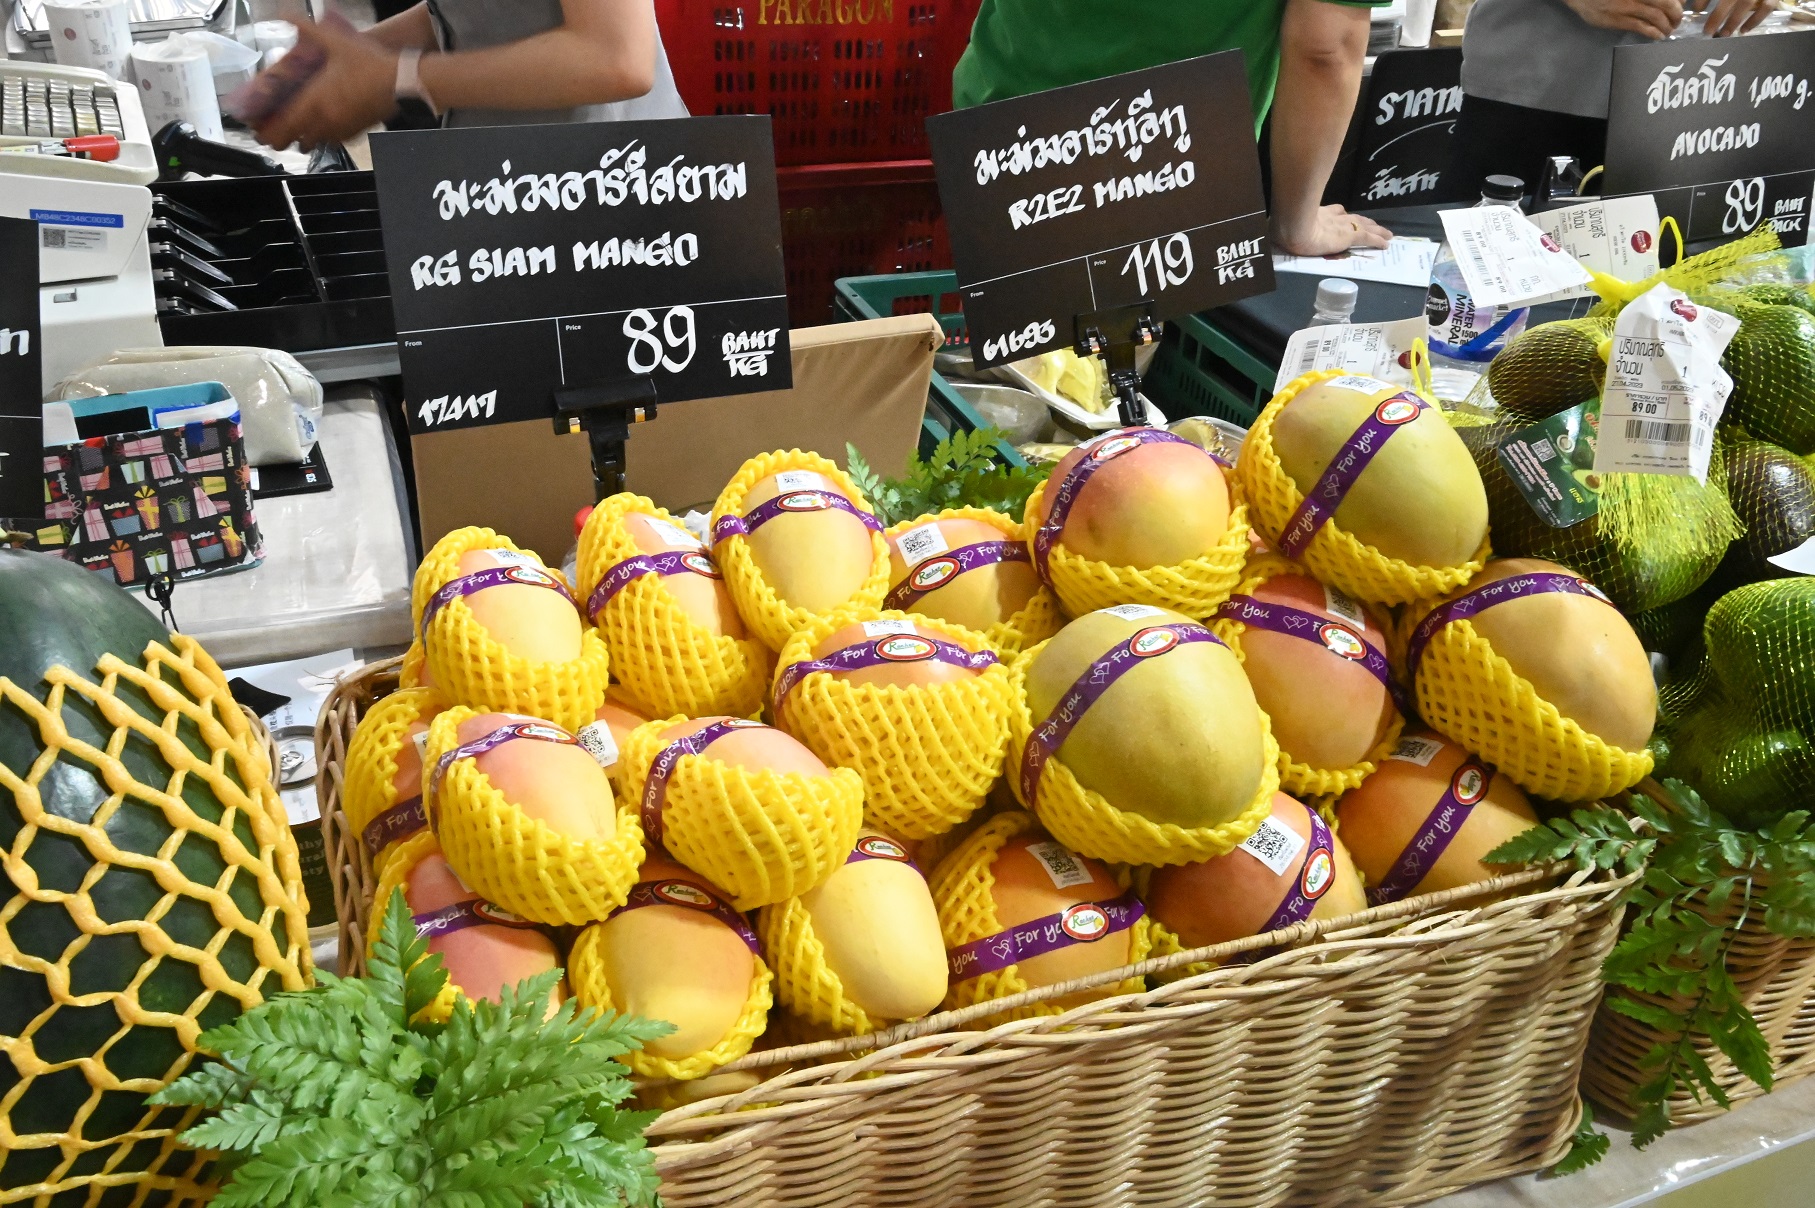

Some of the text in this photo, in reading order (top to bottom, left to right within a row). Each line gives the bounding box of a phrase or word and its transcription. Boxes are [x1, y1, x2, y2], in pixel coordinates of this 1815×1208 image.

[1748, 73, 1793, 108] 1,000
[1670, 122, 1760, 160] AVOCADO
[1008, 161, 1195, 230] R2E2 MANGO
[1722, 177, 1765, 234] 89
[411, 231, 699, 291] RG SIAM MANGO
[1216, 236, 1265, 265] BAHT
[1121, 232, 1194, 296] 119
[1218, 262, 1255, 285] KG
[1448, 293, 1467, 345] MINERAL
[1463, 299, 1475, 329] WATER
[622, 305, 697, 374] 89
[722, 328, 781, 354] BAHT
[983, 319, 1056, 361] 61693
[728, 354, 768, 378] KG
[1682, 366, 1687, 378] 1
[1631, 401, 1657, 414] 89.00
[1337, 450, 1357, 473] For
[716, 518, 736, 534] For
[1287, 526, 1302, 546] For
[976, 545, 997, 557] For
[467, 573, 492, 586] For
[599, 573, 615, 595] For
[1481, 584, 1504, 600] For
[840, 646, 868, 662] For
[1111, 649, 1130, 664] Fo
[1038, 719, 1058, 742] For
[645, 781, 658, 809] For
[386, 810, 409, 831] For
[1416, 829, 1437, 853] For
[1288, 896, 1304, 914] Fo
[1014, 928, 1040, 948] For
